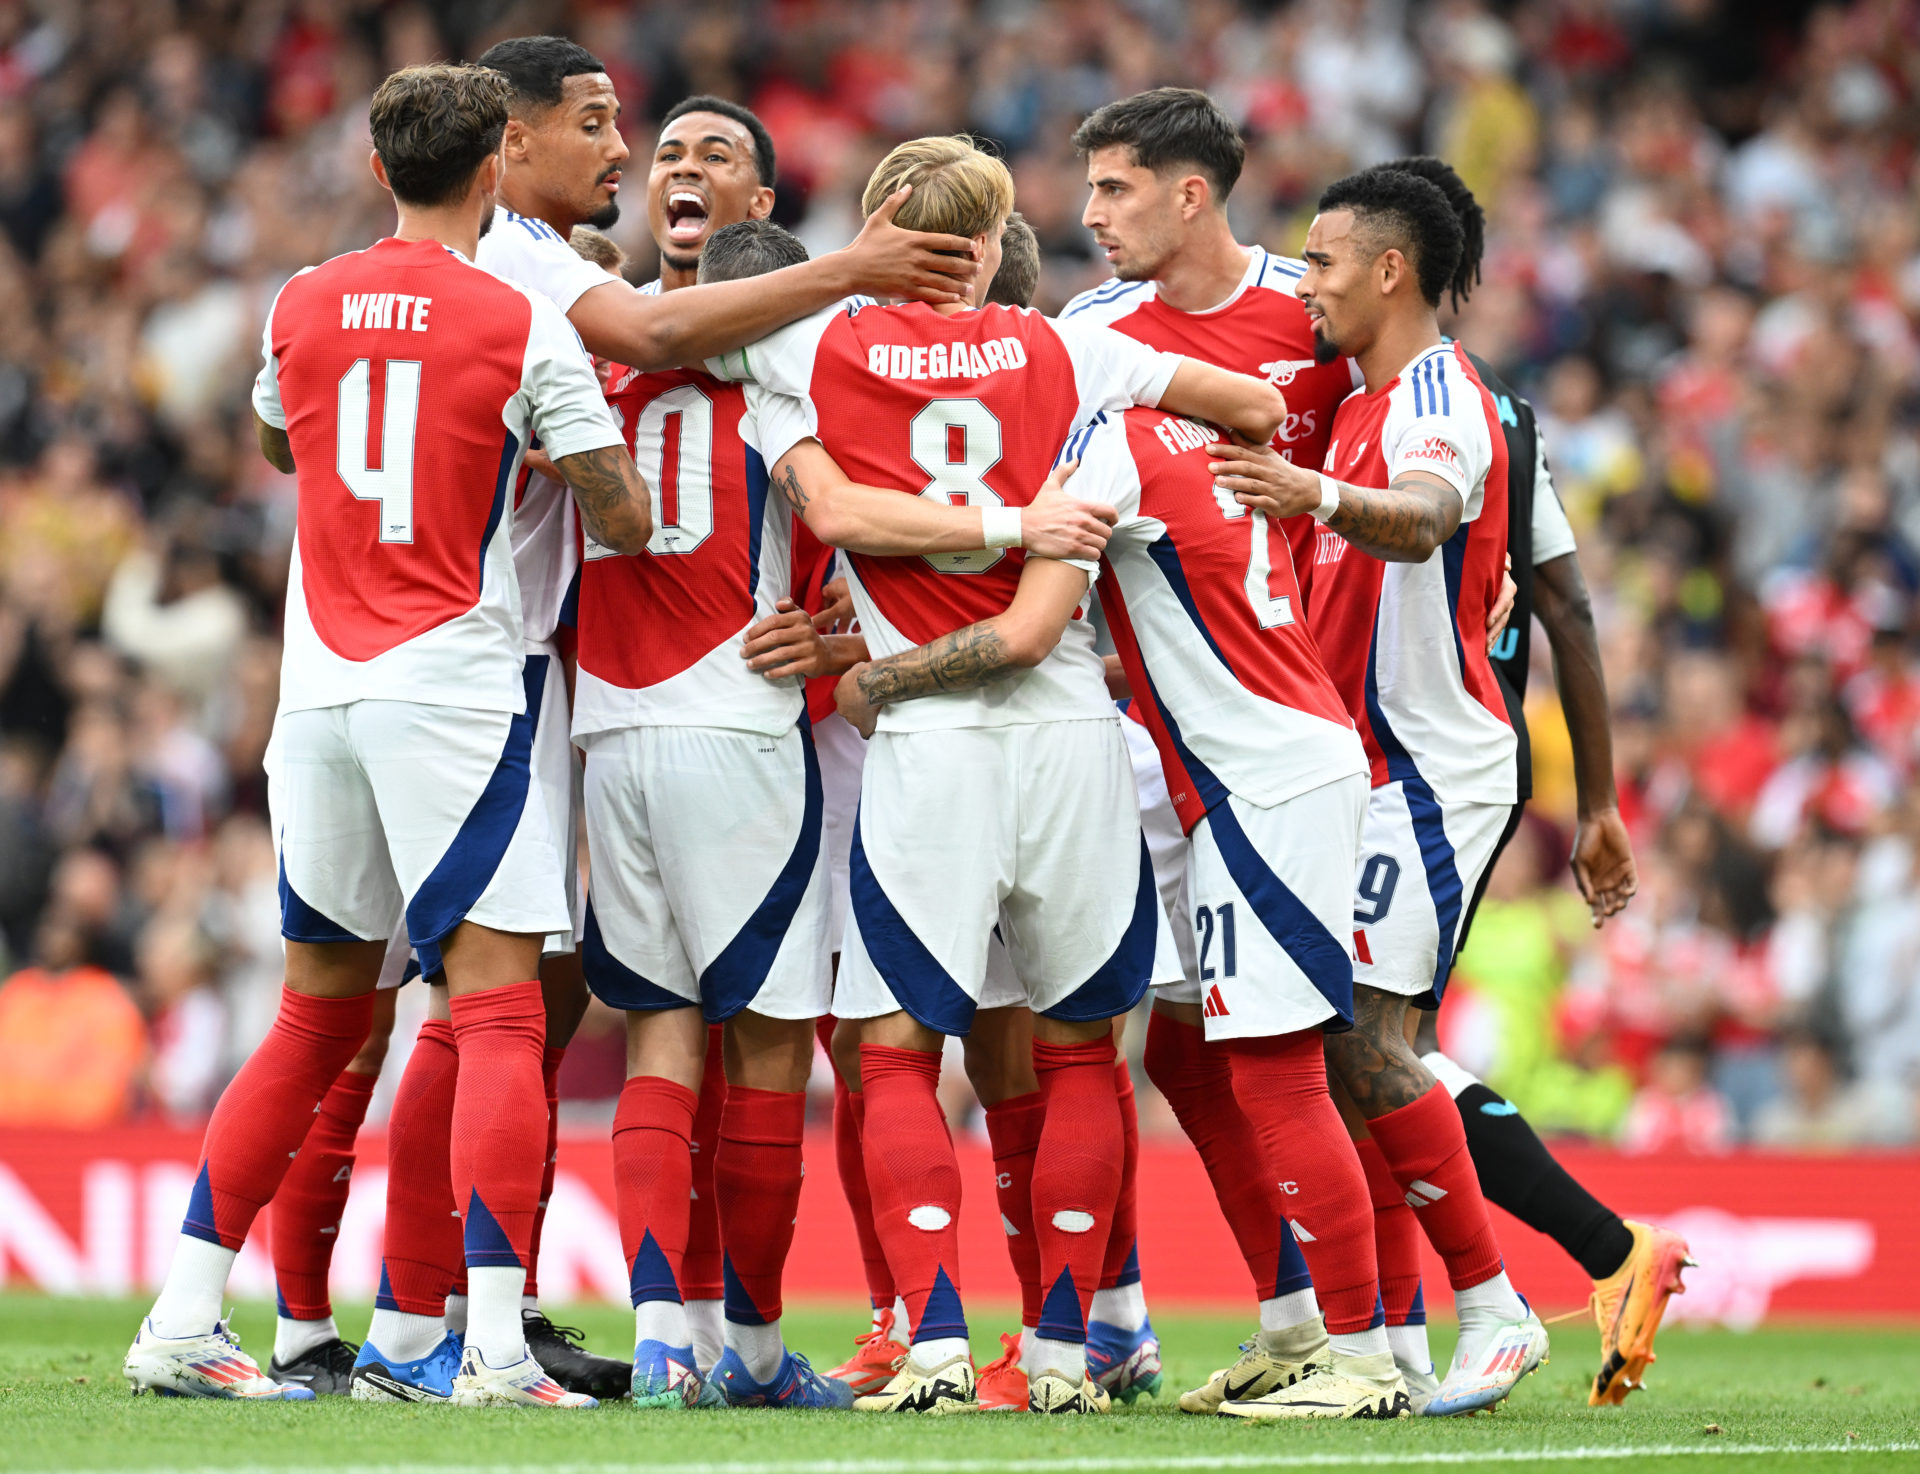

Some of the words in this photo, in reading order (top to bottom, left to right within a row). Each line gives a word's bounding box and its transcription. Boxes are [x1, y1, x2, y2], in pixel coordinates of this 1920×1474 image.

[342, 293, 432, 332] WHITE
[868, 337, 1028, 379] ØDEGAARD
[337, 358, 422, 544] 4
[910, 398, 1006, 574] 8
[1353, 852, 1402, 926] 9
[1196, 901, 1237, 982] 21
